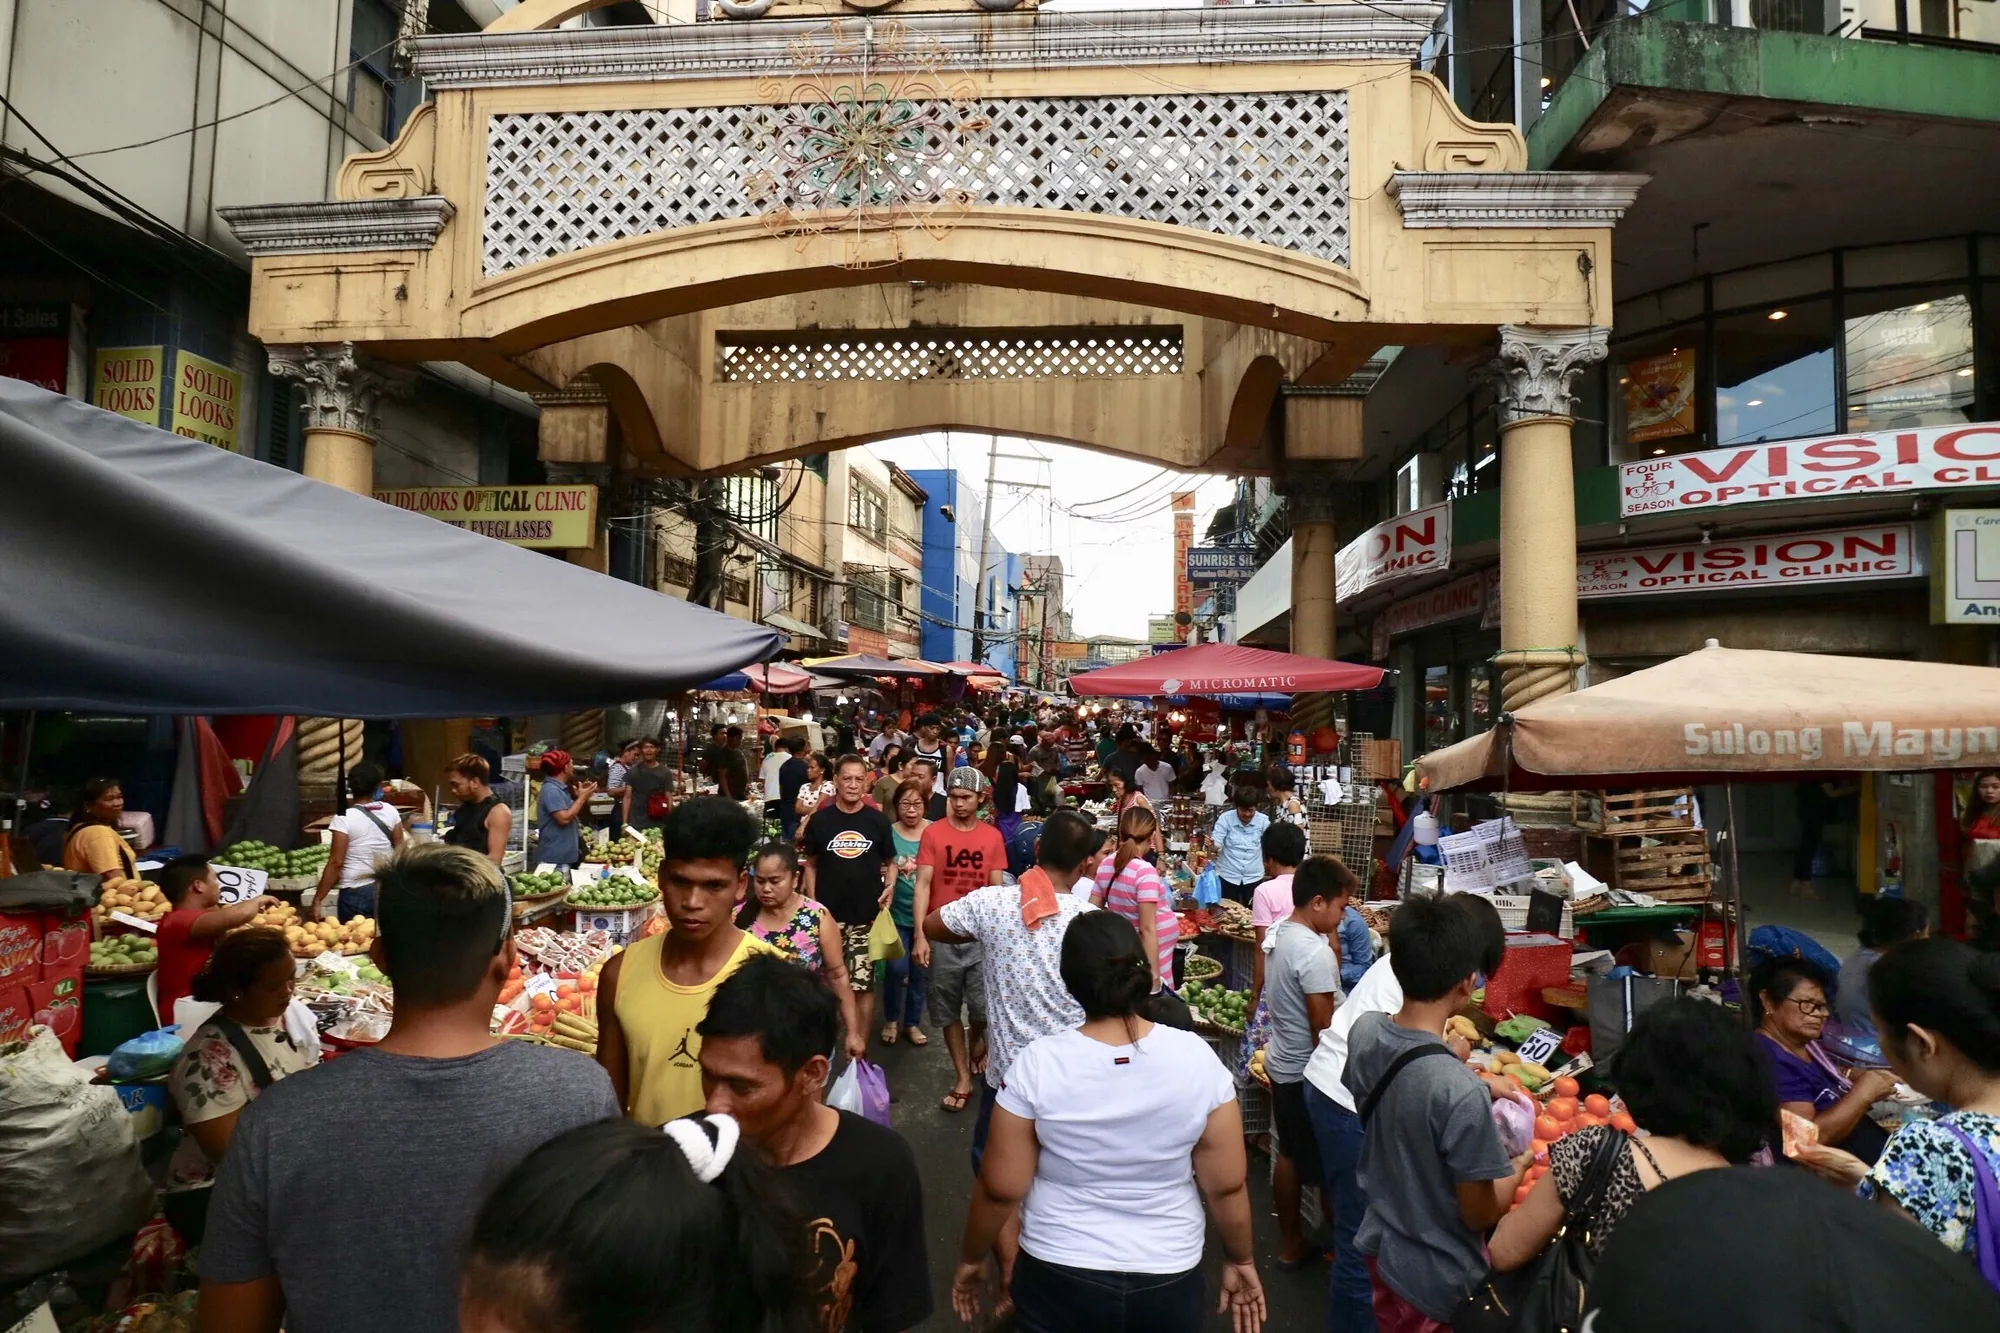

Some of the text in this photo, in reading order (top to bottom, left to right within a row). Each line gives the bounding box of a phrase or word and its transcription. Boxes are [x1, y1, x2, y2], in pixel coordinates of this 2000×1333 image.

[103, 358, 154, 384] SOLID
[183, 364, 233, 401] SOLID
[100, 387, 156, 411] LOOKS
[179, 391, 235, 431] LOOKS
[1626, 461, 1673, 476] FOUR
[1679, 471, 1913, 505] OPTICAL
[463, 490, 531, 511] OPTICAL
[535, 490, 587, 511] CLINIC
[1627, 498, 1675, 513] SEASON
[471, 520, 552, 539] EYEGLASSES
[1189, 554, 1236, 567] SUNRISE
[1632, 533, 1896, 574] VISION
[1639, 559, 1897, 588] OPTICAL CLINIC
[1190, 675, 1297, 690] MICROMATIC
[1683, 722, 1823, 761] Sulong
[832, 841, 867, 849] Dickies
[945, 845, 984, 870] Lee
[1521, 1036, 1551, 1060] 50
